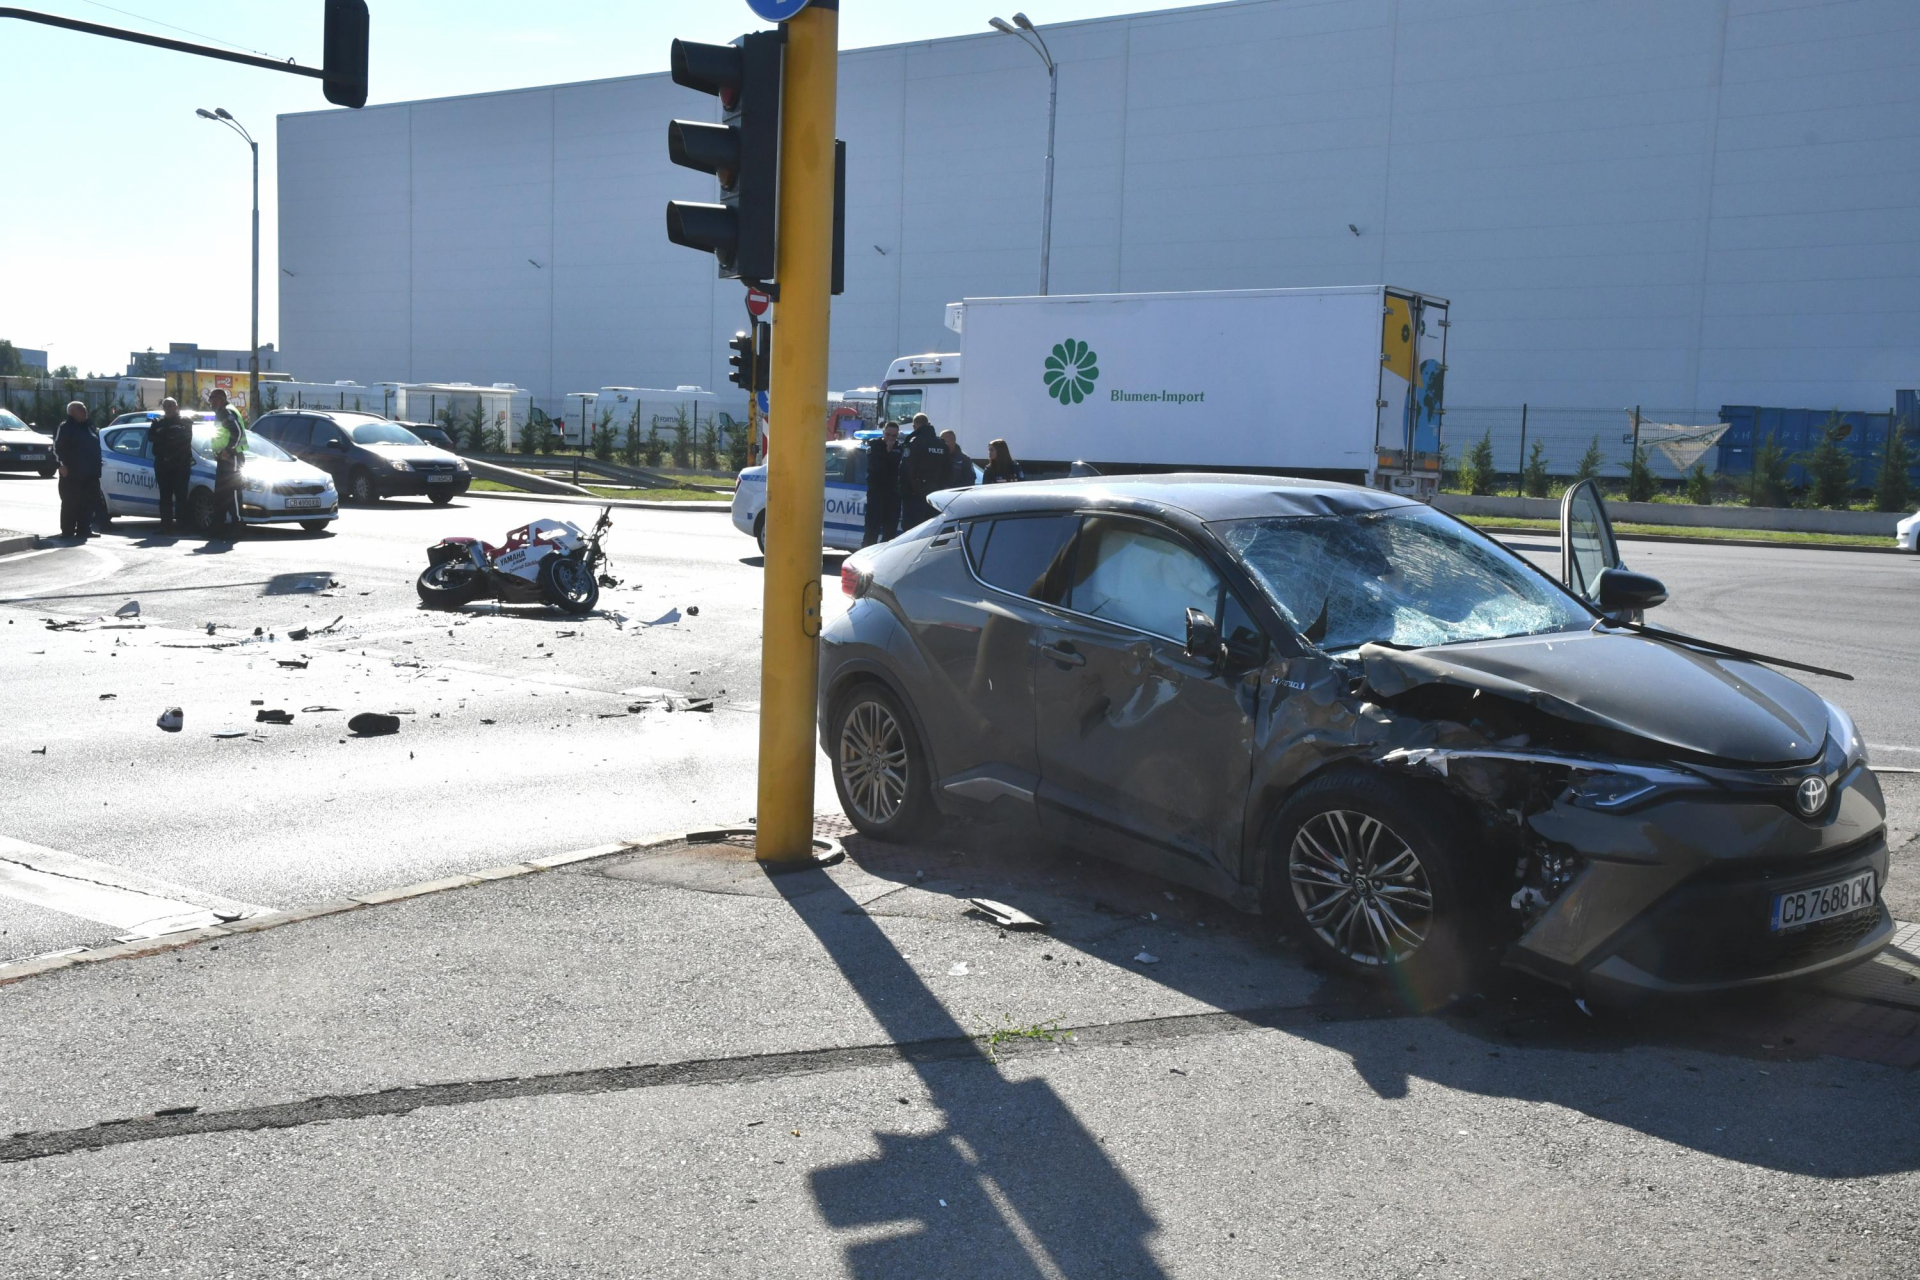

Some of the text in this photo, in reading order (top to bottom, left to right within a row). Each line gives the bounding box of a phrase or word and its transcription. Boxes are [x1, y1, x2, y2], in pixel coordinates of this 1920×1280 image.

[1110, 389, 1205, 405] Blumen-Import
[928, 447, 944, 455] POLICE
[823, 499, 867, 516] ОЛИЦ
[500, 550, 526, 566] YAMAHA
[1809, 883, 1849, 918] 7688
